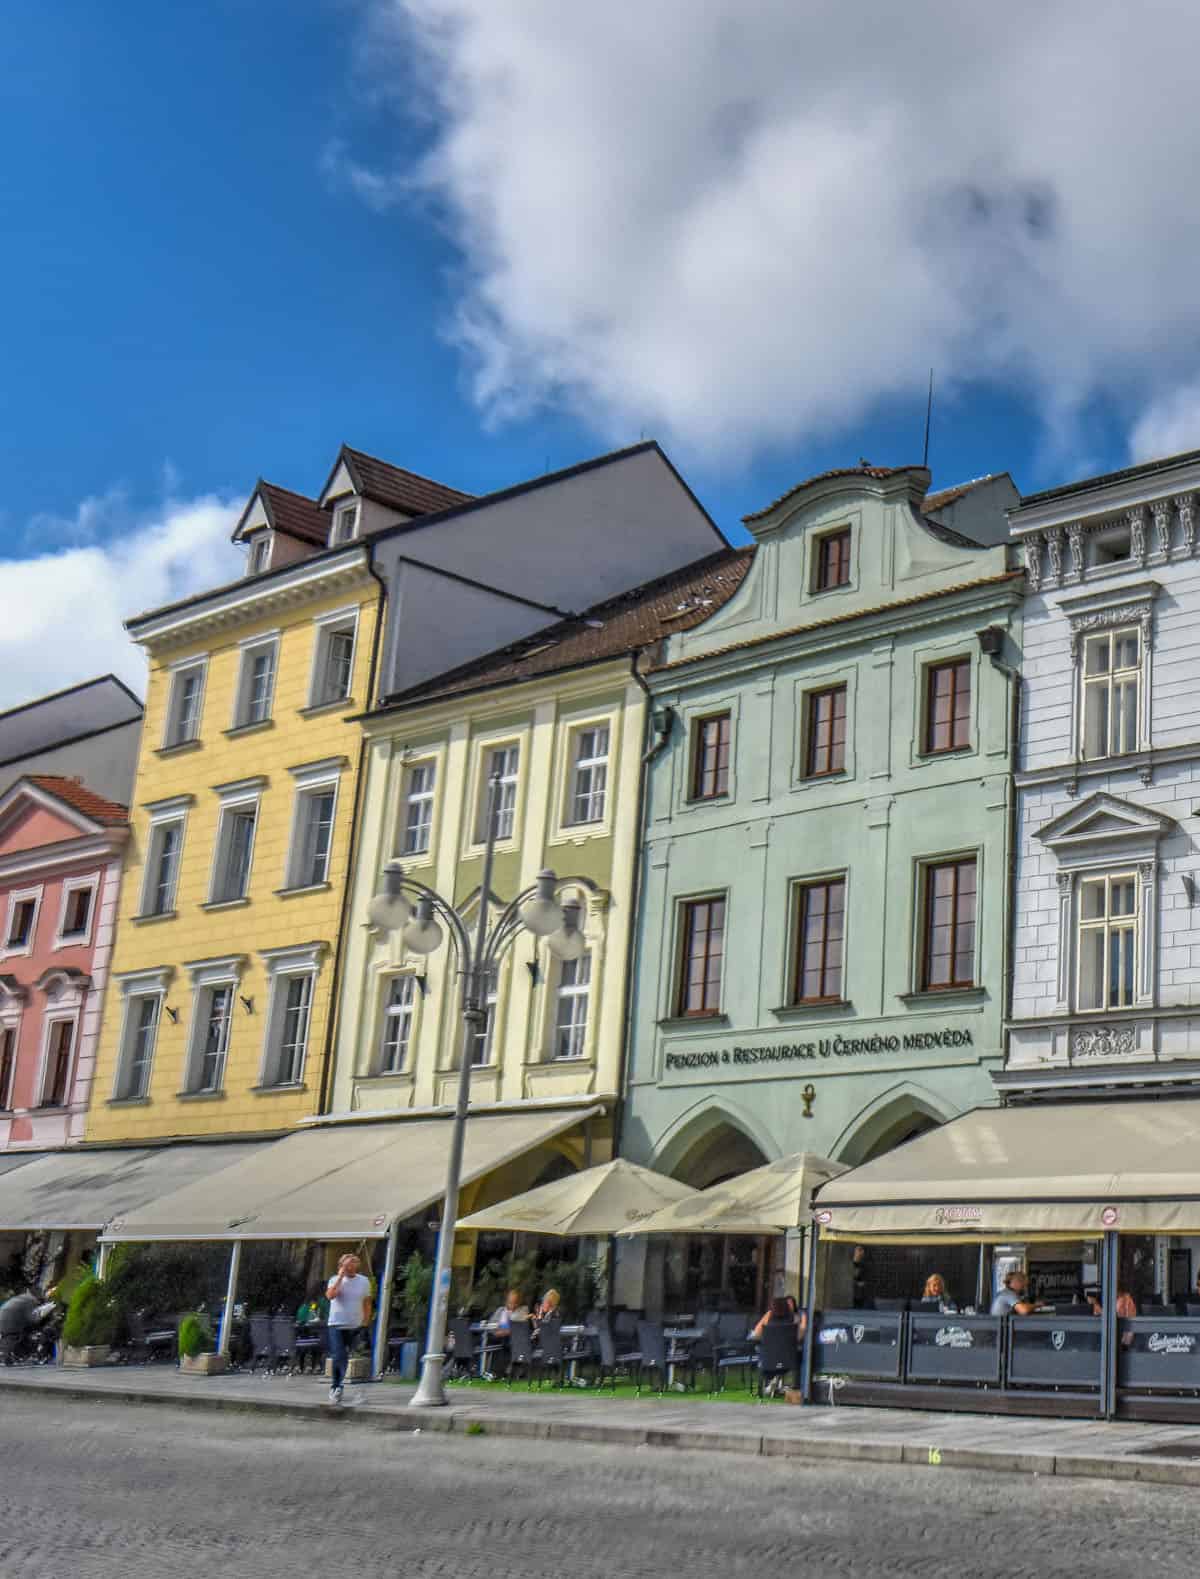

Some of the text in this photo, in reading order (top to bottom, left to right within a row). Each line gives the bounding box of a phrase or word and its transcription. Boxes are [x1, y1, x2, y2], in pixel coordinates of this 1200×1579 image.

[665, 1050, 719, 1069] PENZION
[733, 1042, 816, 1064] RESTAURACE
[819, 1039, 830, 1057] U
[833, 1033, 899, 1056] ČERNÉHO
[903, 1027, 973, 1049] MEDVĚDA
